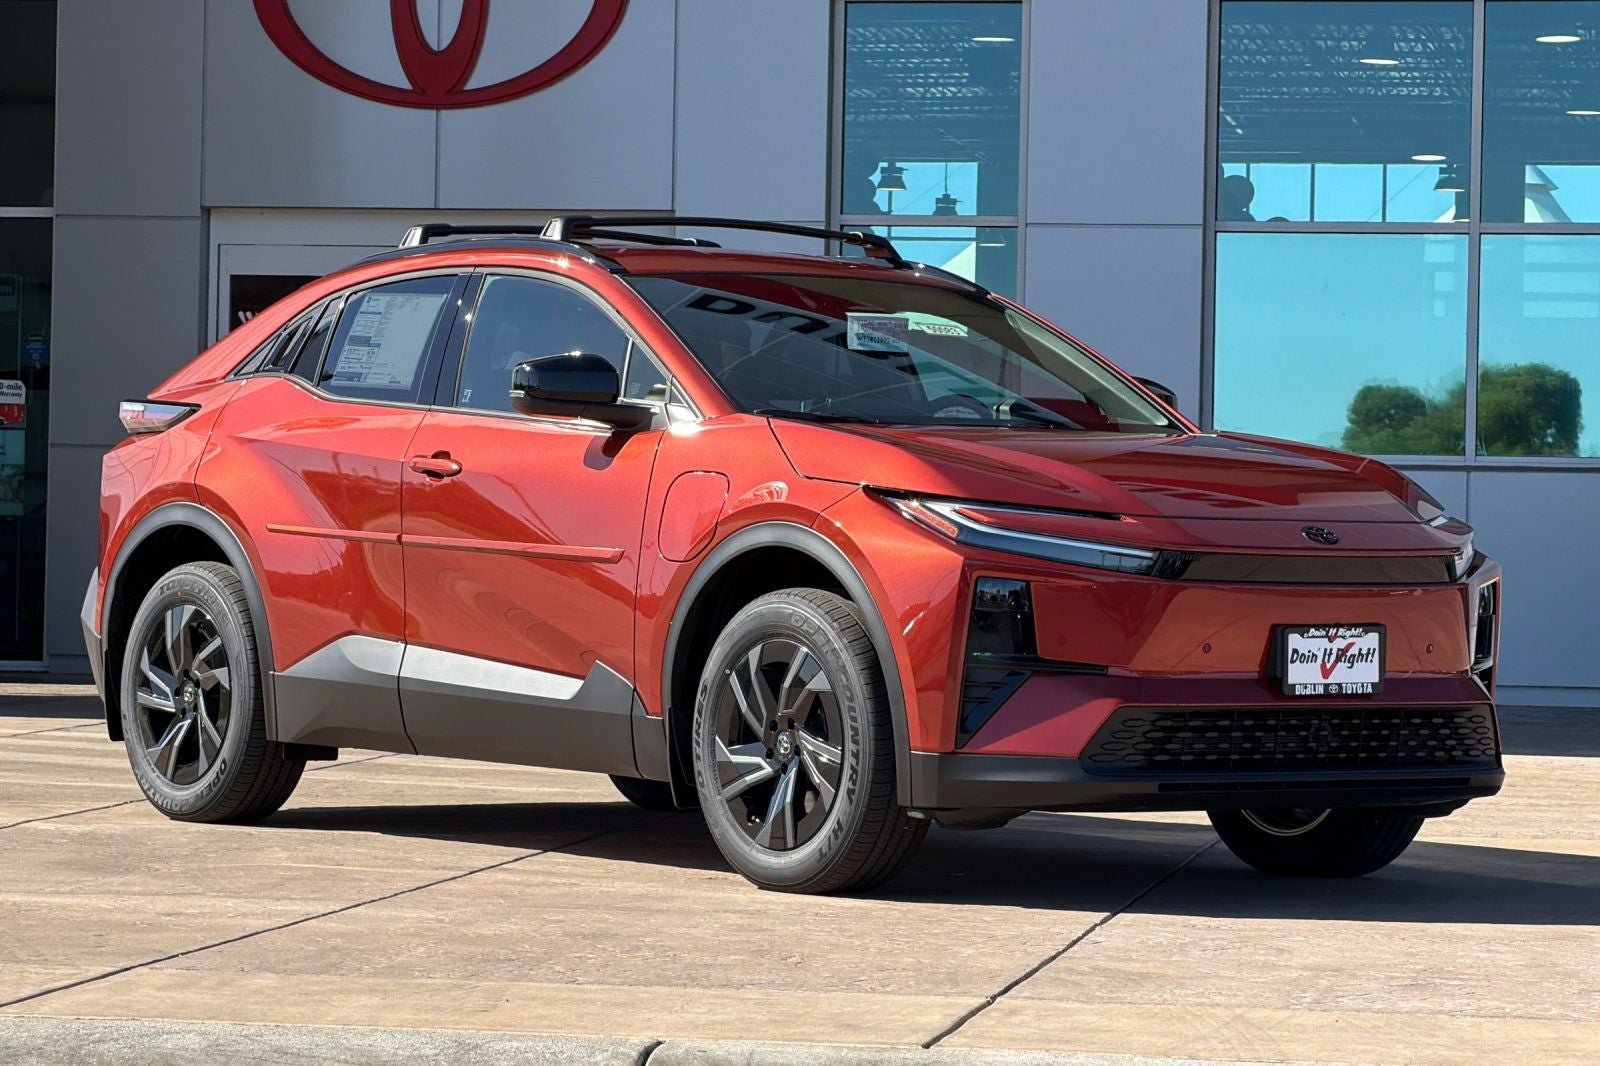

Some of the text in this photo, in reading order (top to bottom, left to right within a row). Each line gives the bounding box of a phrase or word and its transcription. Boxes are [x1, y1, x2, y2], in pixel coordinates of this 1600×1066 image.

[1337, 628, 1363, 638] Right!
[1322, 647, 1334, 664] It
[1336, 647, 1377, 669] Right!
[1295, 683, 1373, 695] DUBLIN TOYOTA
[693, 683, 709, 763] TIRES
